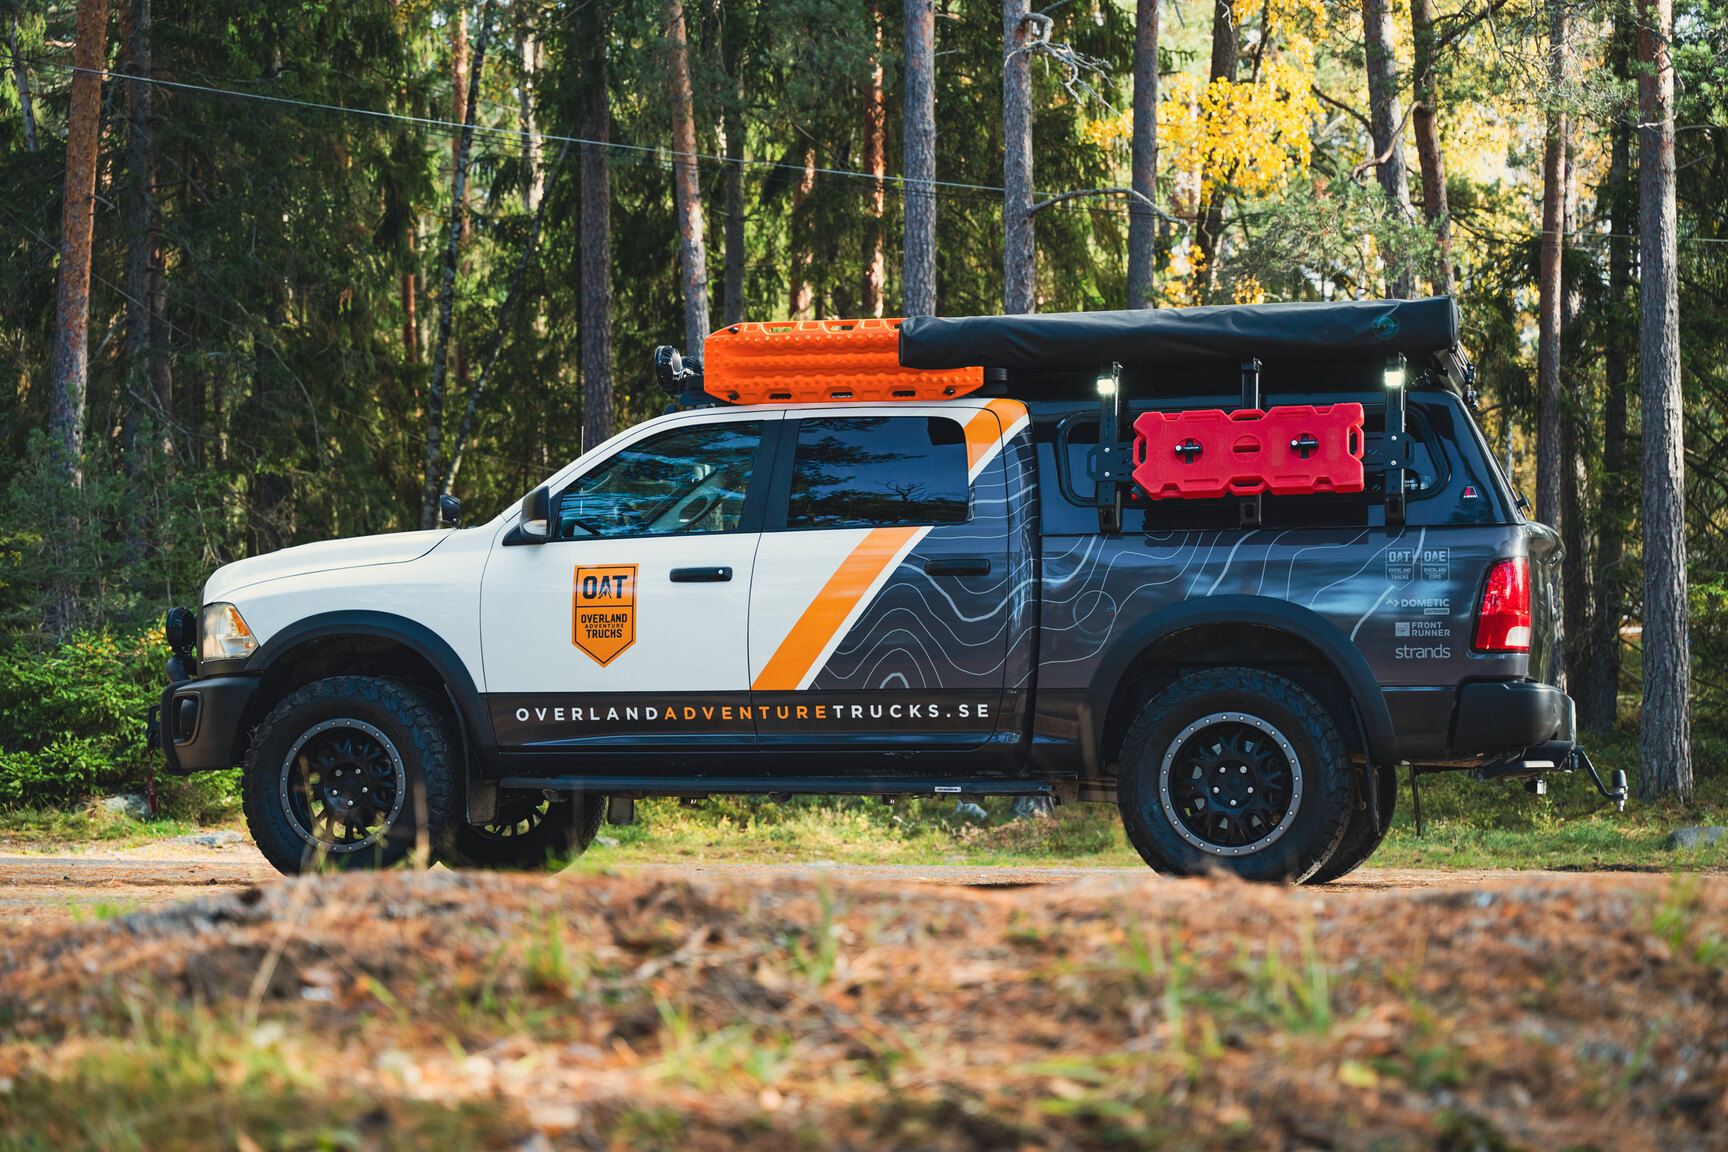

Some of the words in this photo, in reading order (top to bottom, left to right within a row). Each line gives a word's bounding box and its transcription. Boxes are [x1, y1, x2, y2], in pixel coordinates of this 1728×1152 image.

[1388, 551, 1411, 562] OAT
[1423, 550, 1446, 562] OAE
[582, 575, 628, 599] OAT
[1401, 599, 1450, 607] DOMETIC
[580, 613, 628, 623] OVERLAND
[1411, 621, 1443, 629] FRONT
[586, 629, 623, 639] TRUCKS
[1411, 629, 1450, 637] RUNNER
[1395, 643, 1451, 659] strands
[515, 703, 989, 722] OVERLANDADVENTURETRUCKS.SE
